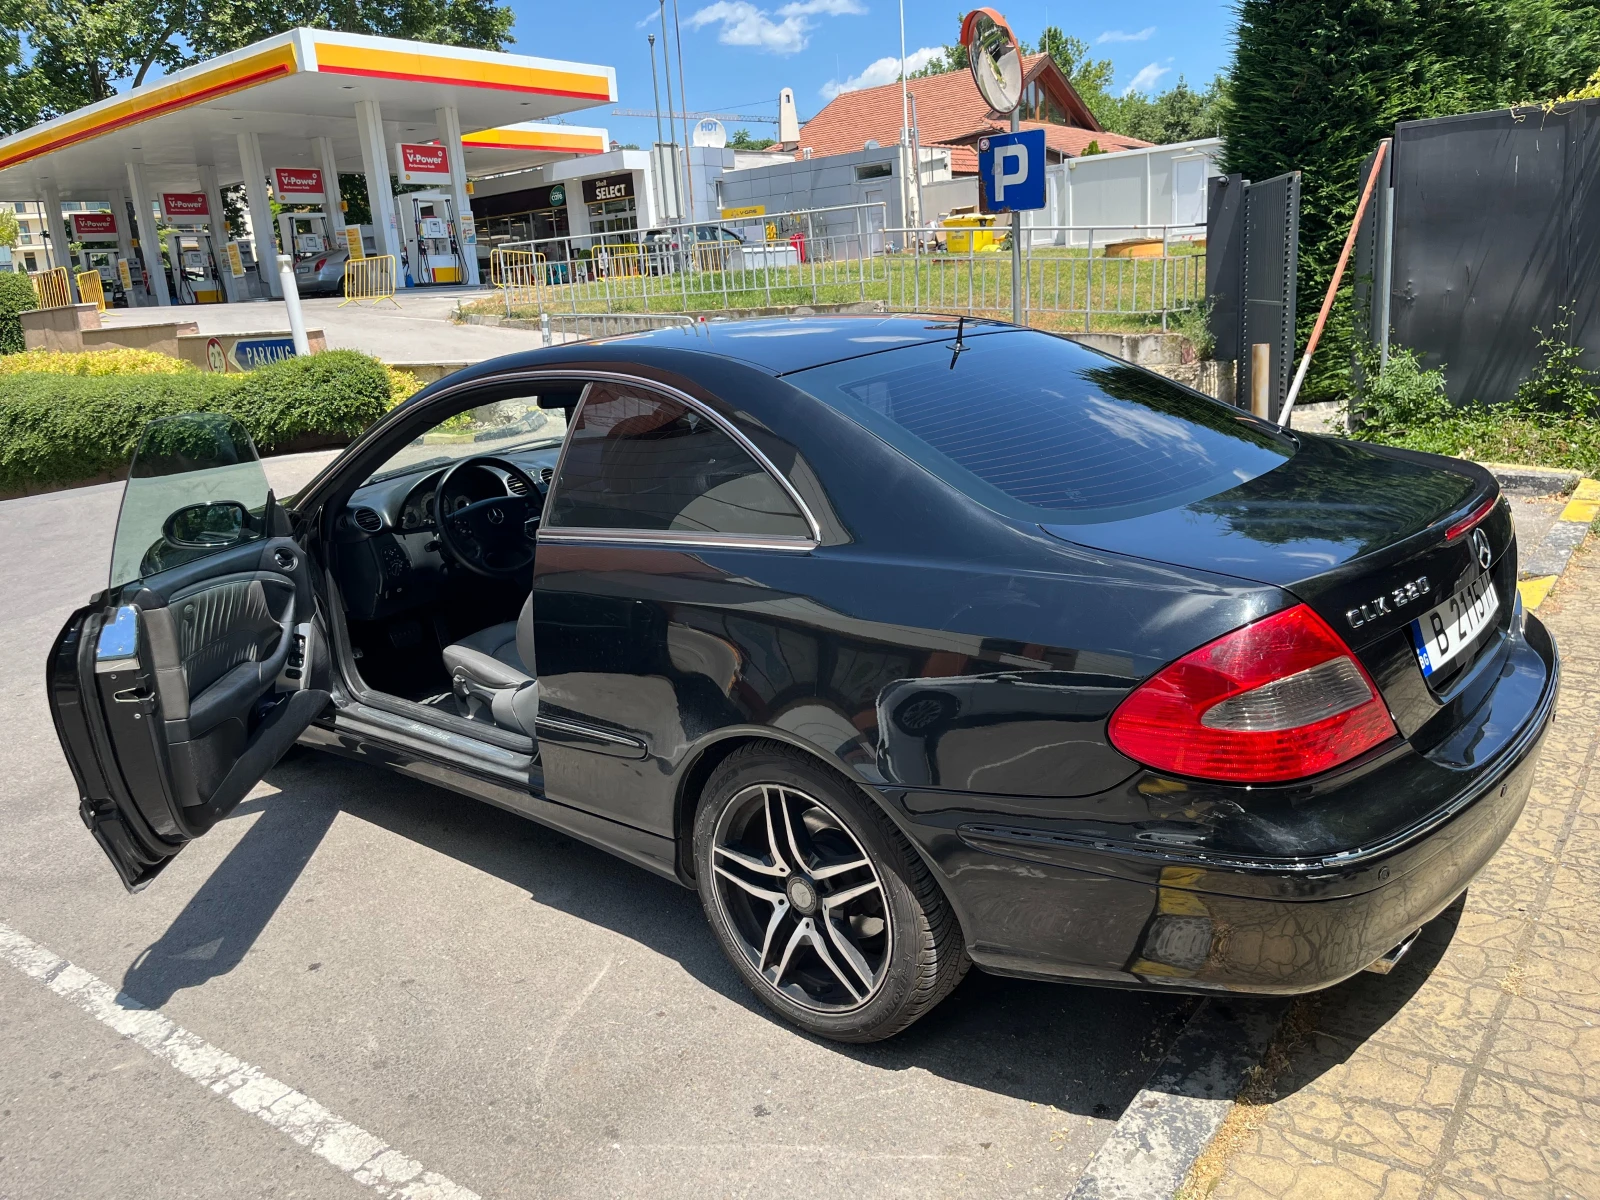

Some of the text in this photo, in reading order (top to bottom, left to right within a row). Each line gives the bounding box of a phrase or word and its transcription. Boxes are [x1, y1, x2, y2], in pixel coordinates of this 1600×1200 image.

[701, 122, 718, 132] HDT
[407, 154, 442, 164] V-Power
[994, 143, 1029, 202] P
[281, 177, 317, 185] V-Power
[596, 184, 626, 200] SELECT
[1345, 576, 1431, 629] CLK 220
[1429, 611, 1450, 658] B
[1418, 653, 1430, 670] BG
